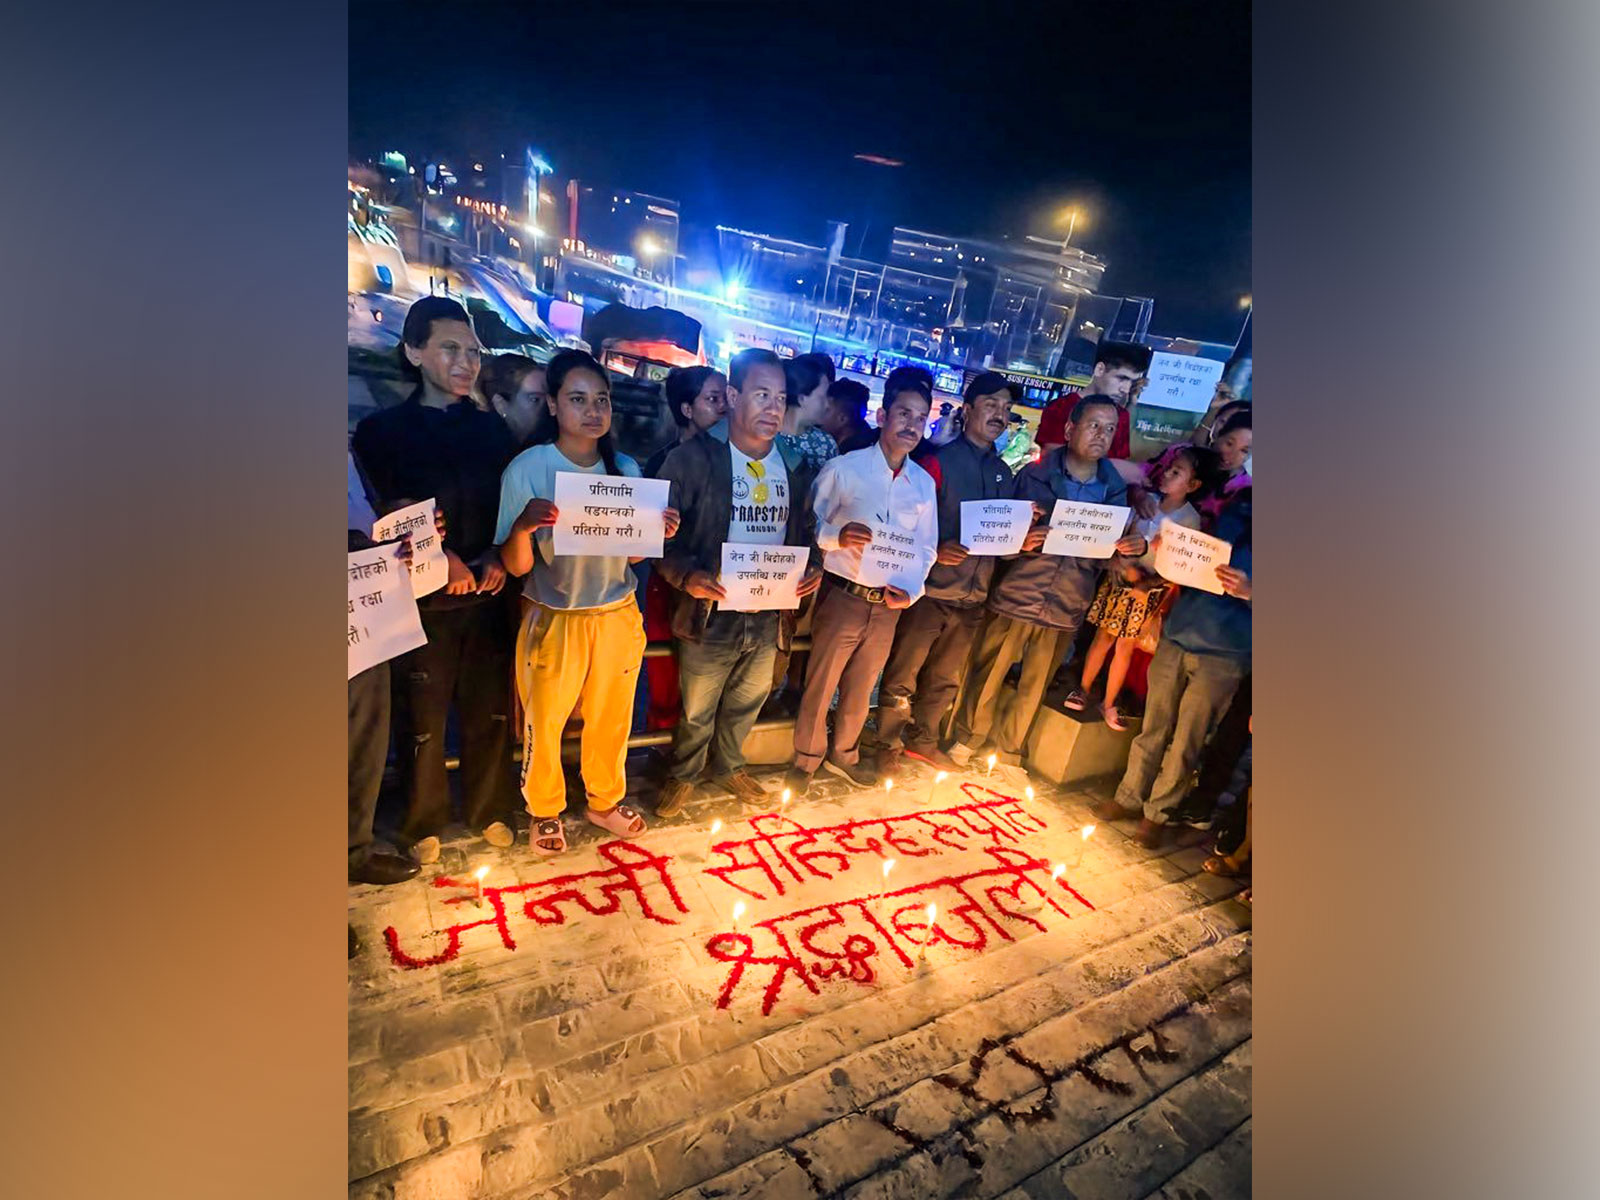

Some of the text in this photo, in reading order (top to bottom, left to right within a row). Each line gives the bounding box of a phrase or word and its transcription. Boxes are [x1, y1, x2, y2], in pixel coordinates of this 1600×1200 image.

[589, 481, 633, 497] प्रतिगामि
[584, 505, 636, 518] षडयन्त्रको
[572, 522, 610, 537] प्रतिरोध
[746, 525, 777, 533] LONDON
[729, 549, 745, 562] जेन
[749, 550, 760, 563] जी
[348, 557, 387, 580] द्रोहको
[737, 569, 787, 580] उपलब्धि रक्षा
[359, 591, 383, 607] रक्षा
